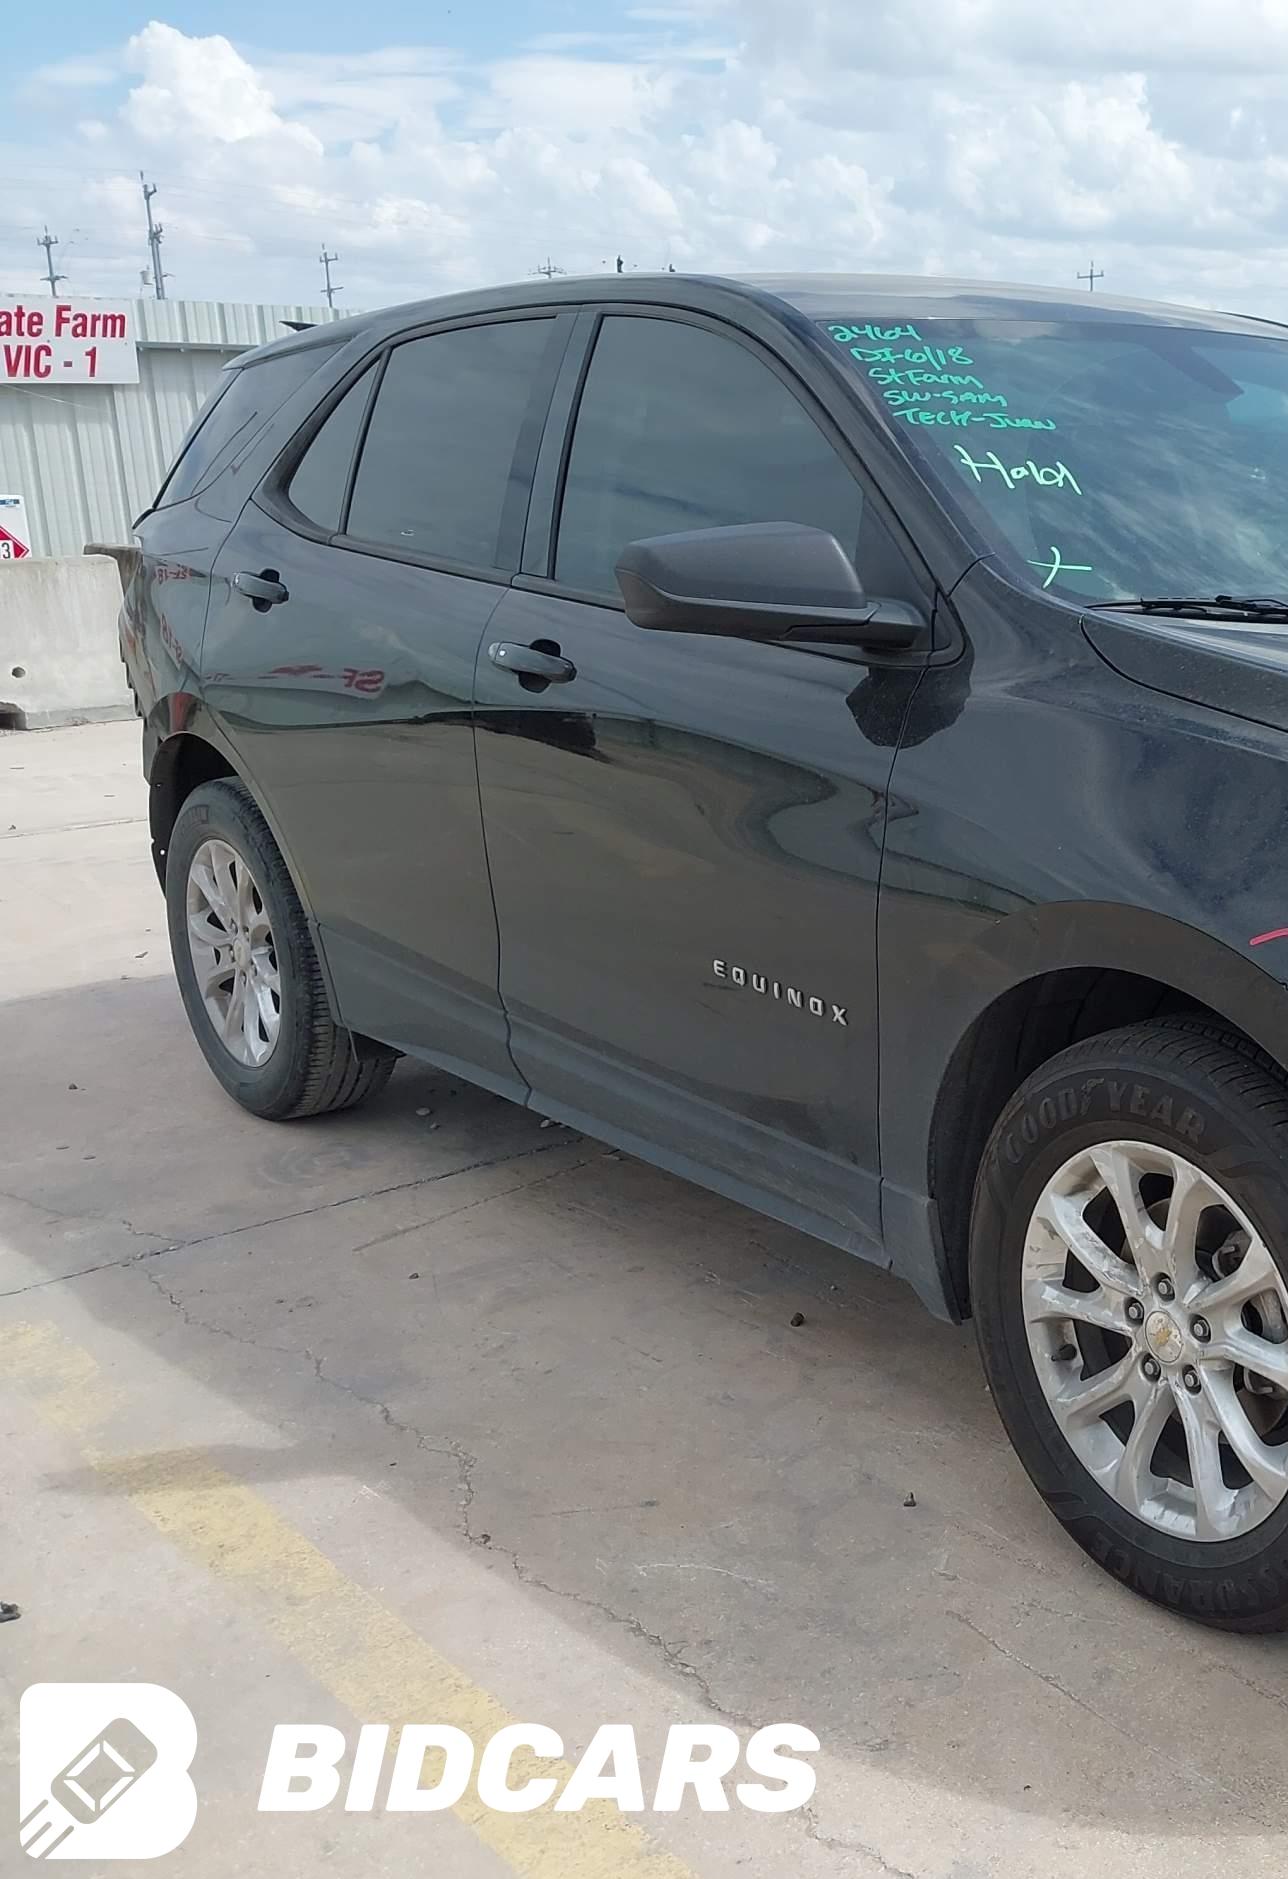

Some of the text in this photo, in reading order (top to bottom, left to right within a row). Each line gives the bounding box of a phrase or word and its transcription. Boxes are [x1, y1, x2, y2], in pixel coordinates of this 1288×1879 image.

[0, 304, 126, 338] ate Farm
[3, 344, 52, 378] VIC
[84, 346, 97, 377] 1
[712, 958, 849, 1027] EQUINOX
